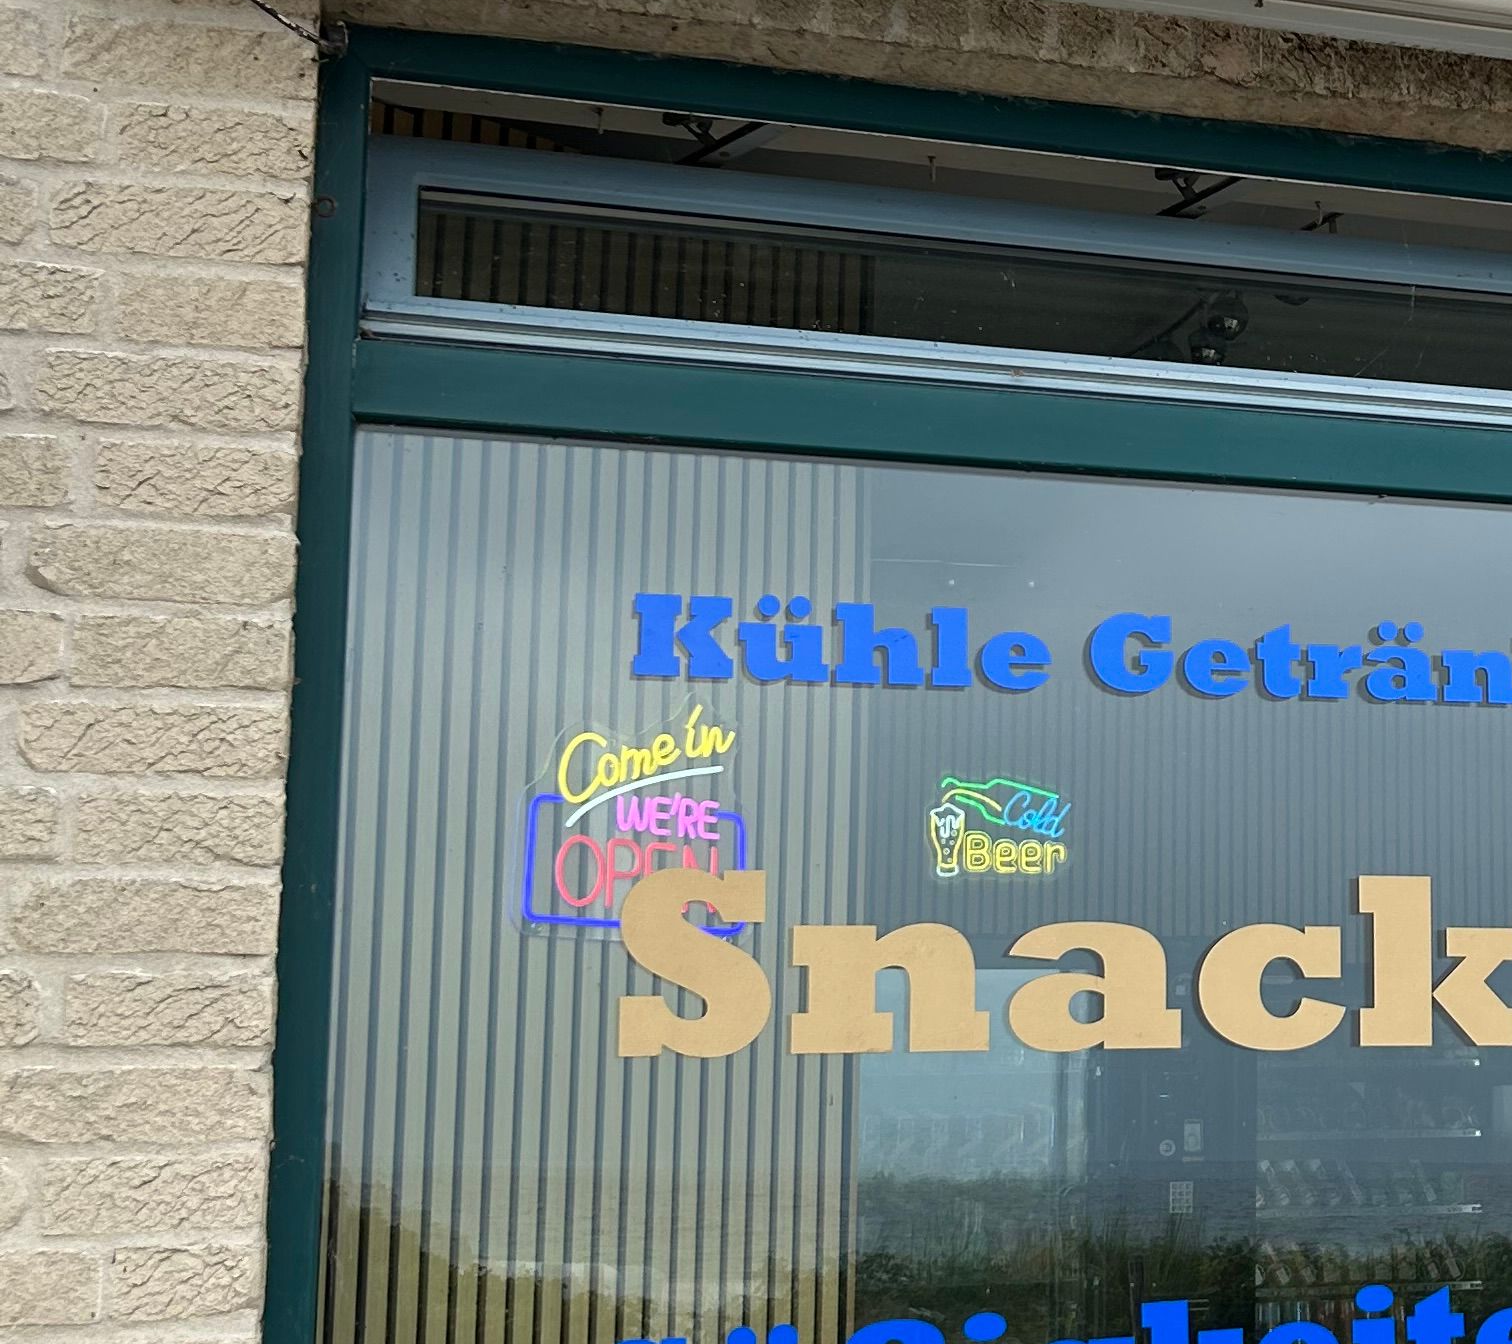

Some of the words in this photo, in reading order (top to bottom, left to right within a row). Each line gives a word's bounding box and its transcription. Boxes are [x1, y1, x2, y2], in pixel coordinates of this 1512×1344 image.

[632, 592, 1053, 692] Kühle
[557, 732, 682, 804] Come
[685, 704, 736, 758] in
[616, 792, 721, 840] WE'RE
[1003, 790, 1072, 838] Cold
[962, 830, 1068, 875] Beer
